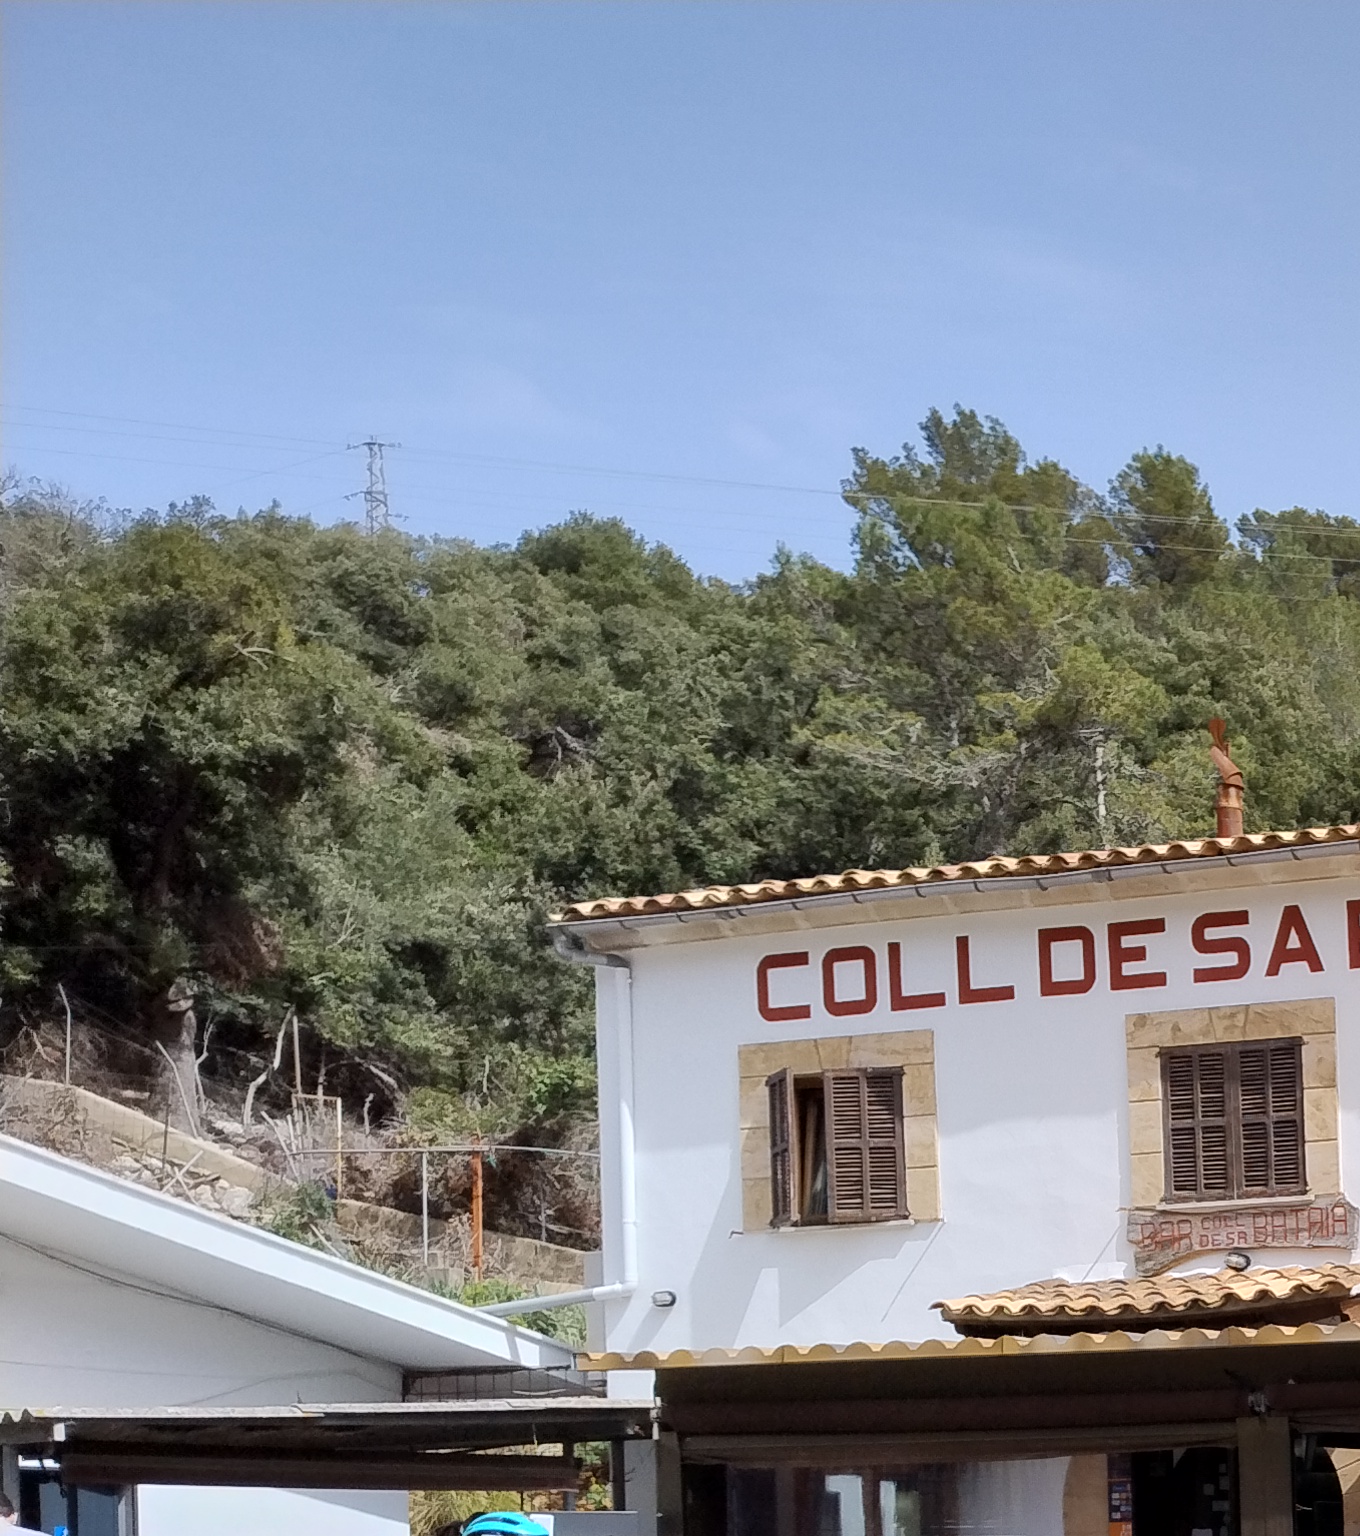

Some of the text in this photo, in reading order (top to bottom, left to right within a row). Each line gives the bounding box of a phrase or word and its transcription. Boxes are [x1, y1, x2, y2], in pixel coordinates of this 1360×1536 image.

[756, 934, 1015, 1022] COLL
[1038, 917, 1168, 997] DE
[1192, 903, 1325, 984] SA
[1140, 1218, 1194, 1251] BAR
[1200, 1233, 1222, 1248] DE
[1252, 1203, 1349, 1243] BATAIA
